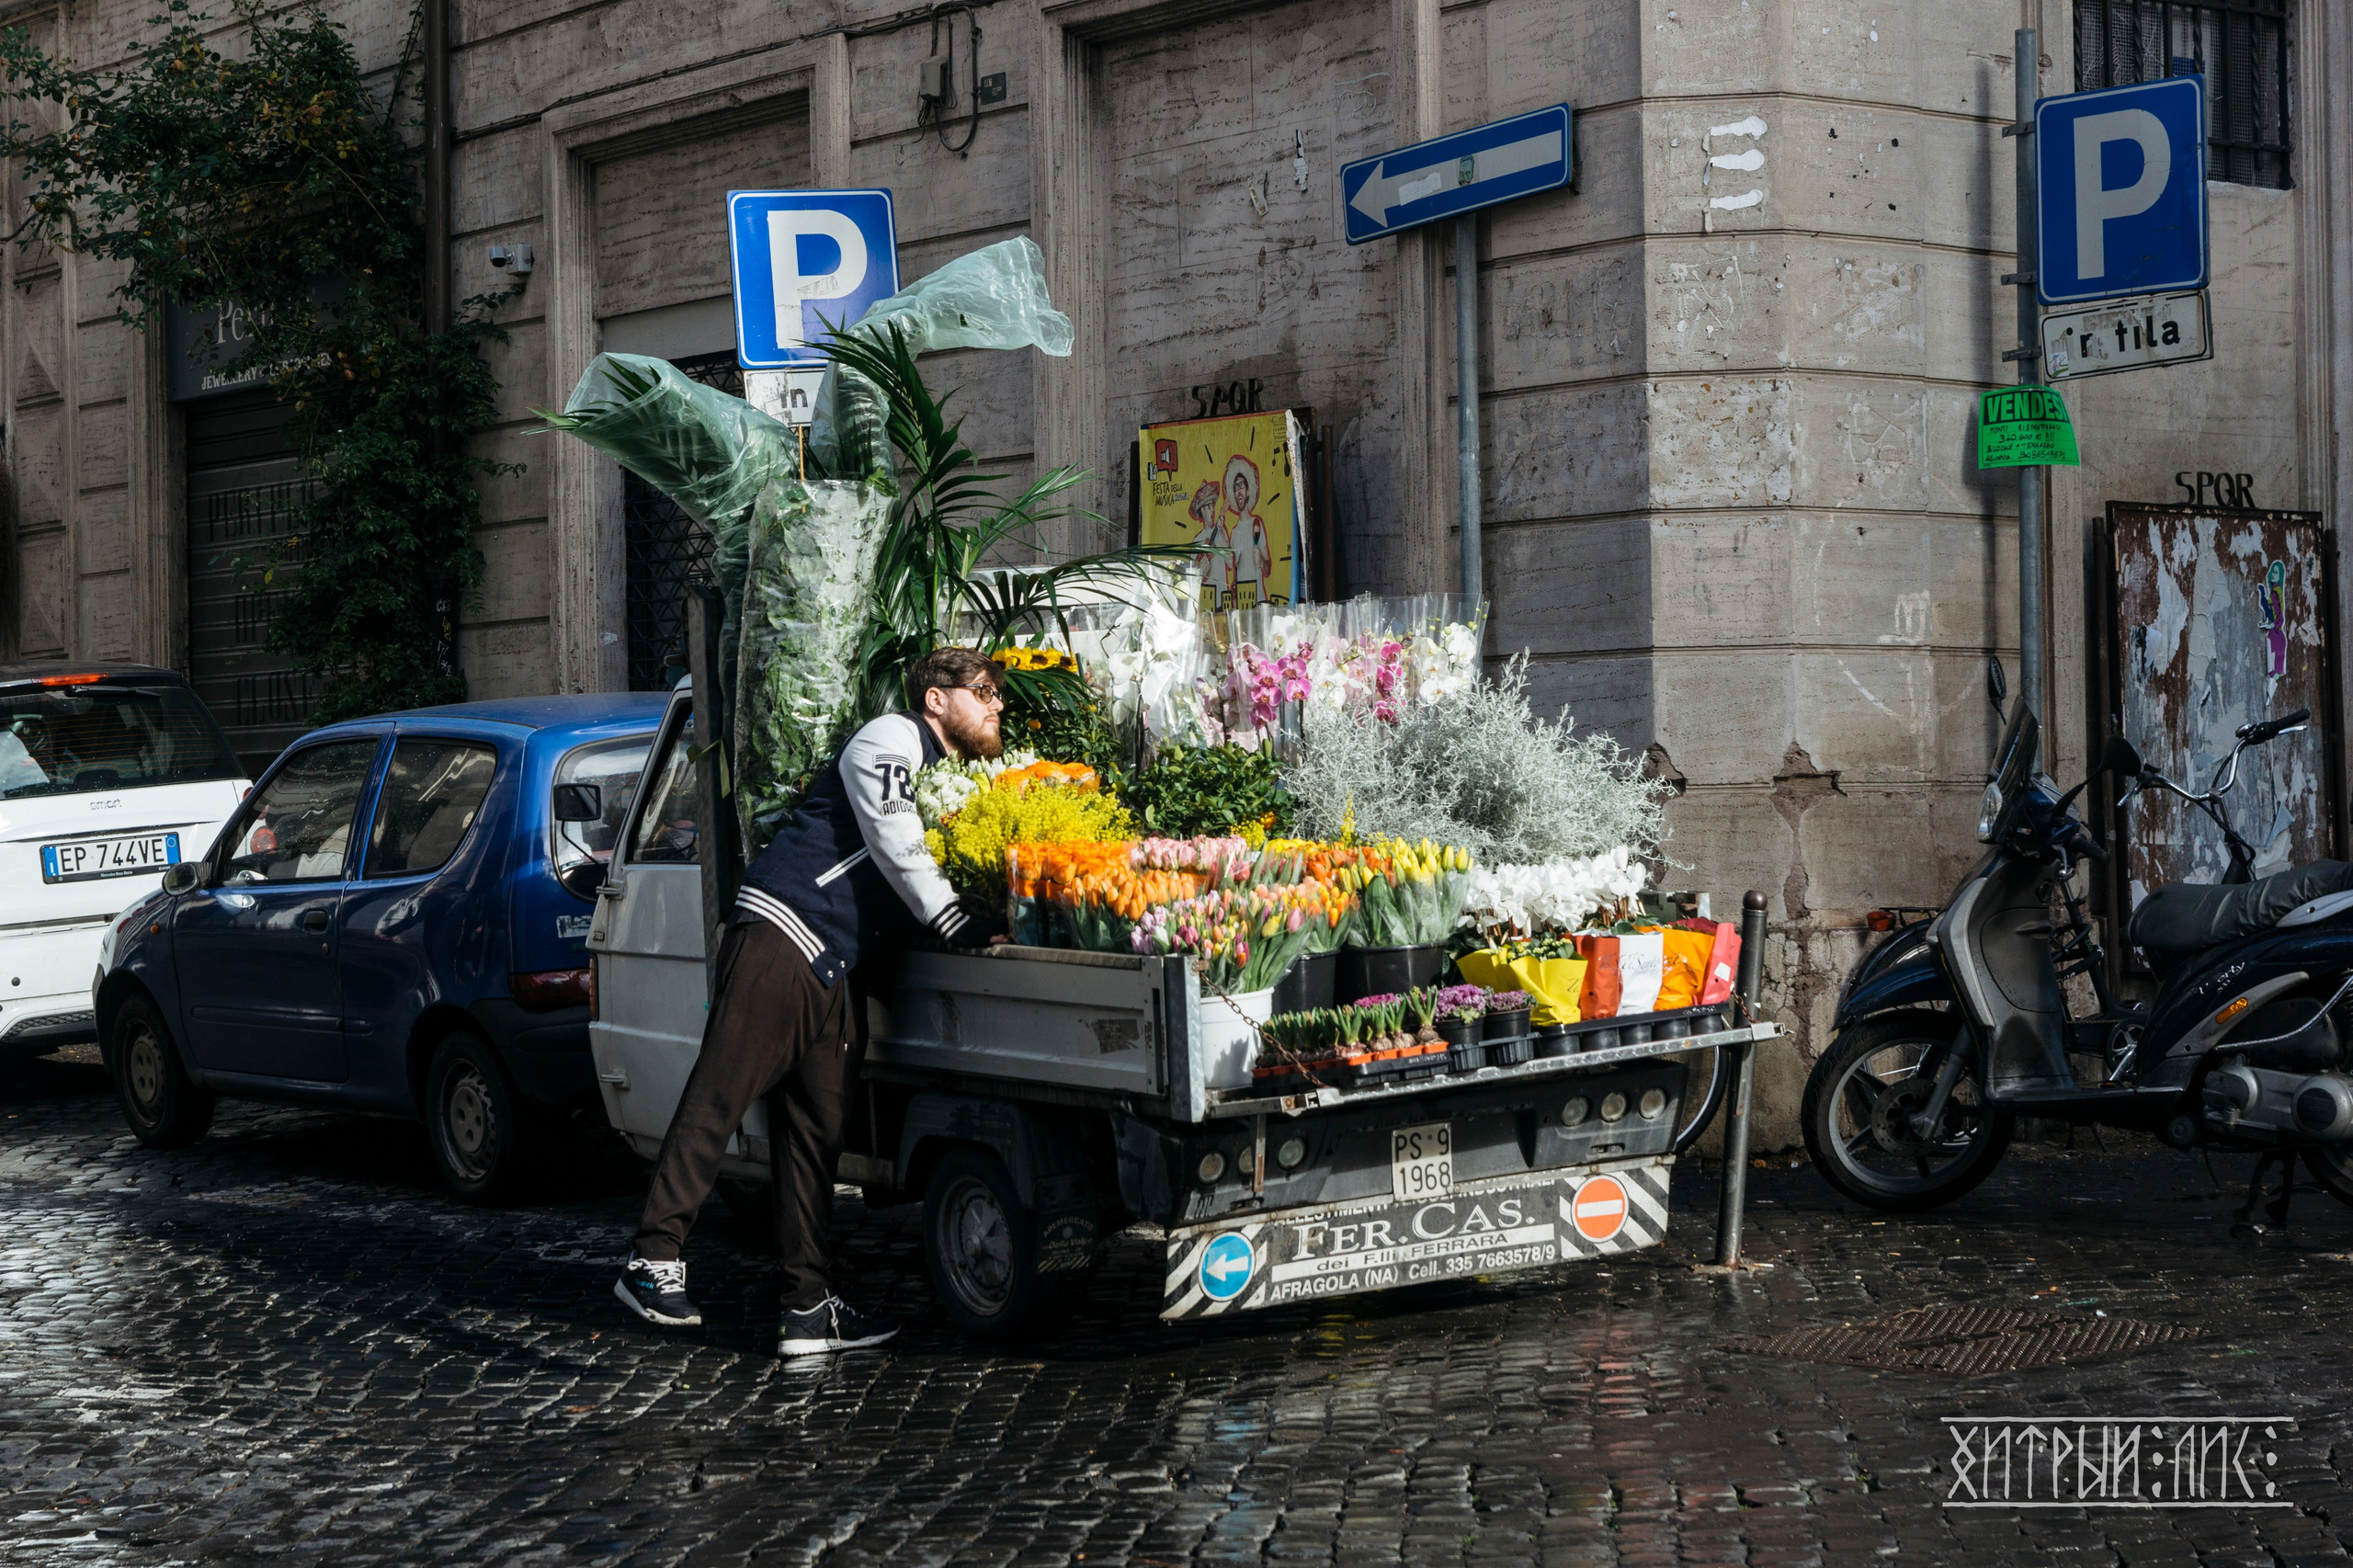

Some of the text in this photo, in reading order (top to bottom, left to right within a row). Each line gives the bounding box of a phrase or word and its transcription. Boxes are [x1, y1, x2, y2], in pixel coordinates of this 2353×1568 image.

[2073, 108, 2171, 279] P
[767, 210, 868, 349] P
[2115, 314, 2181, 353] fila
[1192, 379, 1265, 417] SPQR
[1986, 392, 2068, 423] VENDESI
[2175, 472, 2256, 507] SPQR
[875, 764, 915, 803] 72
[90, 799, 122, 810] smart
[60, 847, 86, 872] EP
[97, 838, 165, 869] 744VE
[1395, 1129, 1449, 1163] PS 9
[1400, 1162, 1451, 1195] 1968
[1316, 1257, 1349, 1271] dei
[1411, 1233, 1508, 1257] FERRARA
[1270, 1244, 1556, 1301] AFRAGOLA (NA) Cell. 335 7663578/9
